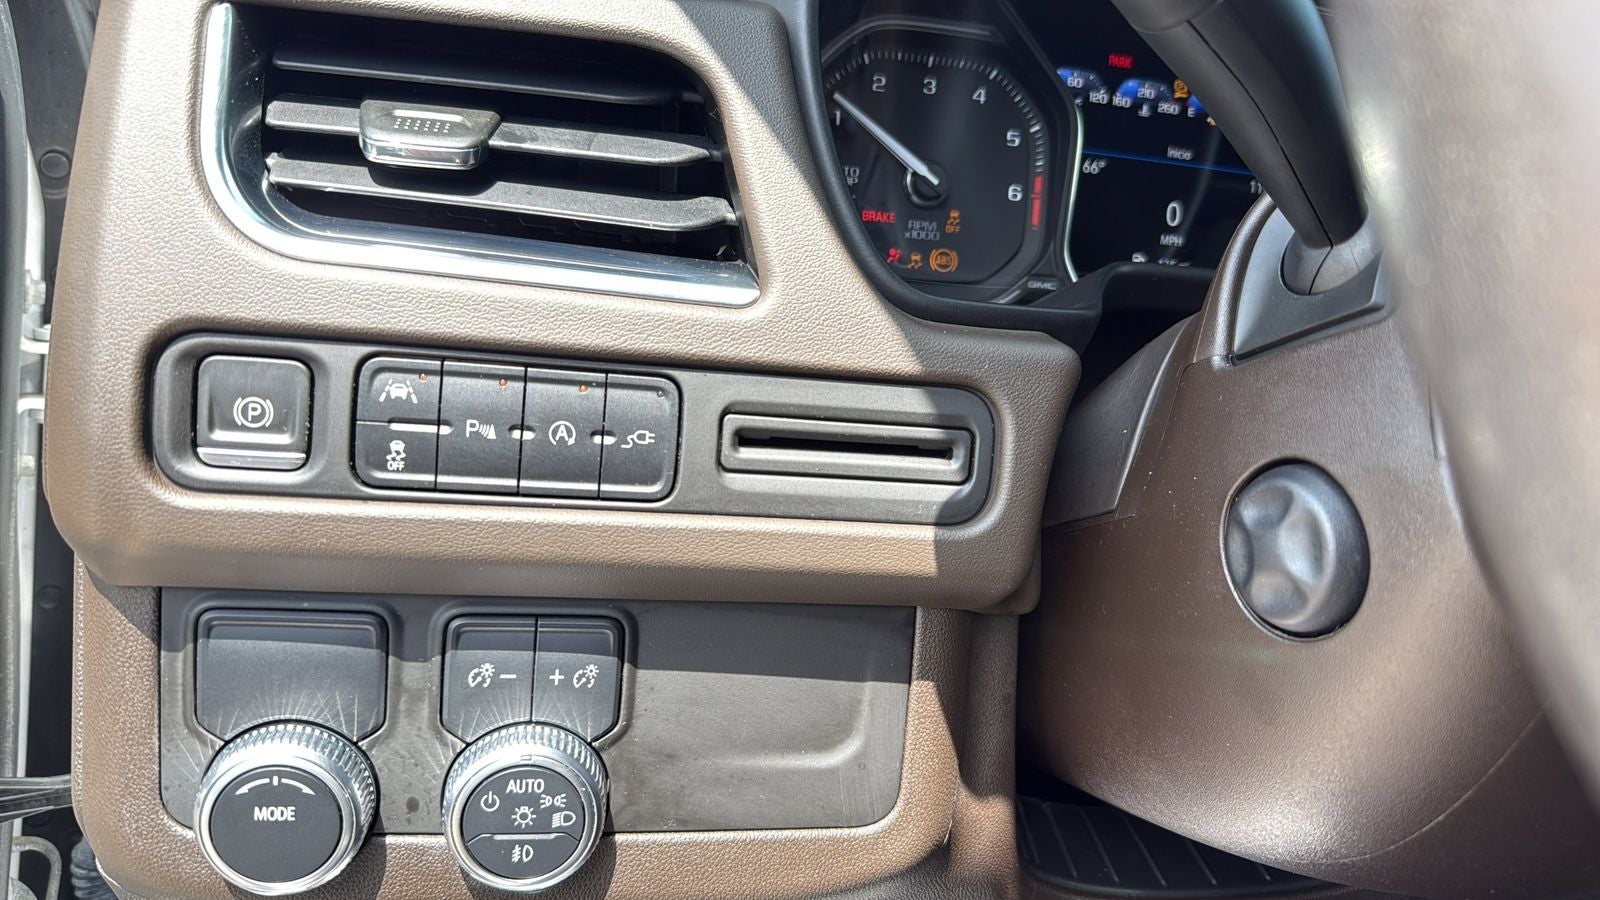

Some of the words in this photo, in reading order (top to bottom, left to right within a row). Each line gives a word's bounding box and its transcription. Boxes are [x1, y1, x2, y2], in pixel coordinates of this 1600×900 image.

[872, 76, 886, 92] 2
[923, 77, 937, 95] 3
[1067, 76, 1083, 89] 60
[972, 88, 987, 105] 4
[1089, 92, 1109, 105] 120
[1137, 87, 1155, 100] 210
[1112, 96, 1132, 108] 160
[1158, 103, 1179, 115] 260
[833, 111, 841, 126] 1
[1006, 129, 1021, 147] 5
[1007, 185, 1023, 202] 6
[862, 209, 896, 224] BRAKE
[1166, 200, 1183, 227] 0
[907, 220, 937, 231] RPM
[945, 224, 961, 234] OFF
[904, 230, 940, 241] x1000
[1160, 234, 1184, 247] MPH
[935, 255, 952, 266] ABS
[1027, 280, 1057, 290] GMC
[246, 404, 261, 422] P
[465, 419, 480, 438] P
[555, 420, 570, 438] A
[386, 459, 405, 472] OFF
[506, 777, 545, 795] AUTO
[253, 805, 296, 822] MODE
